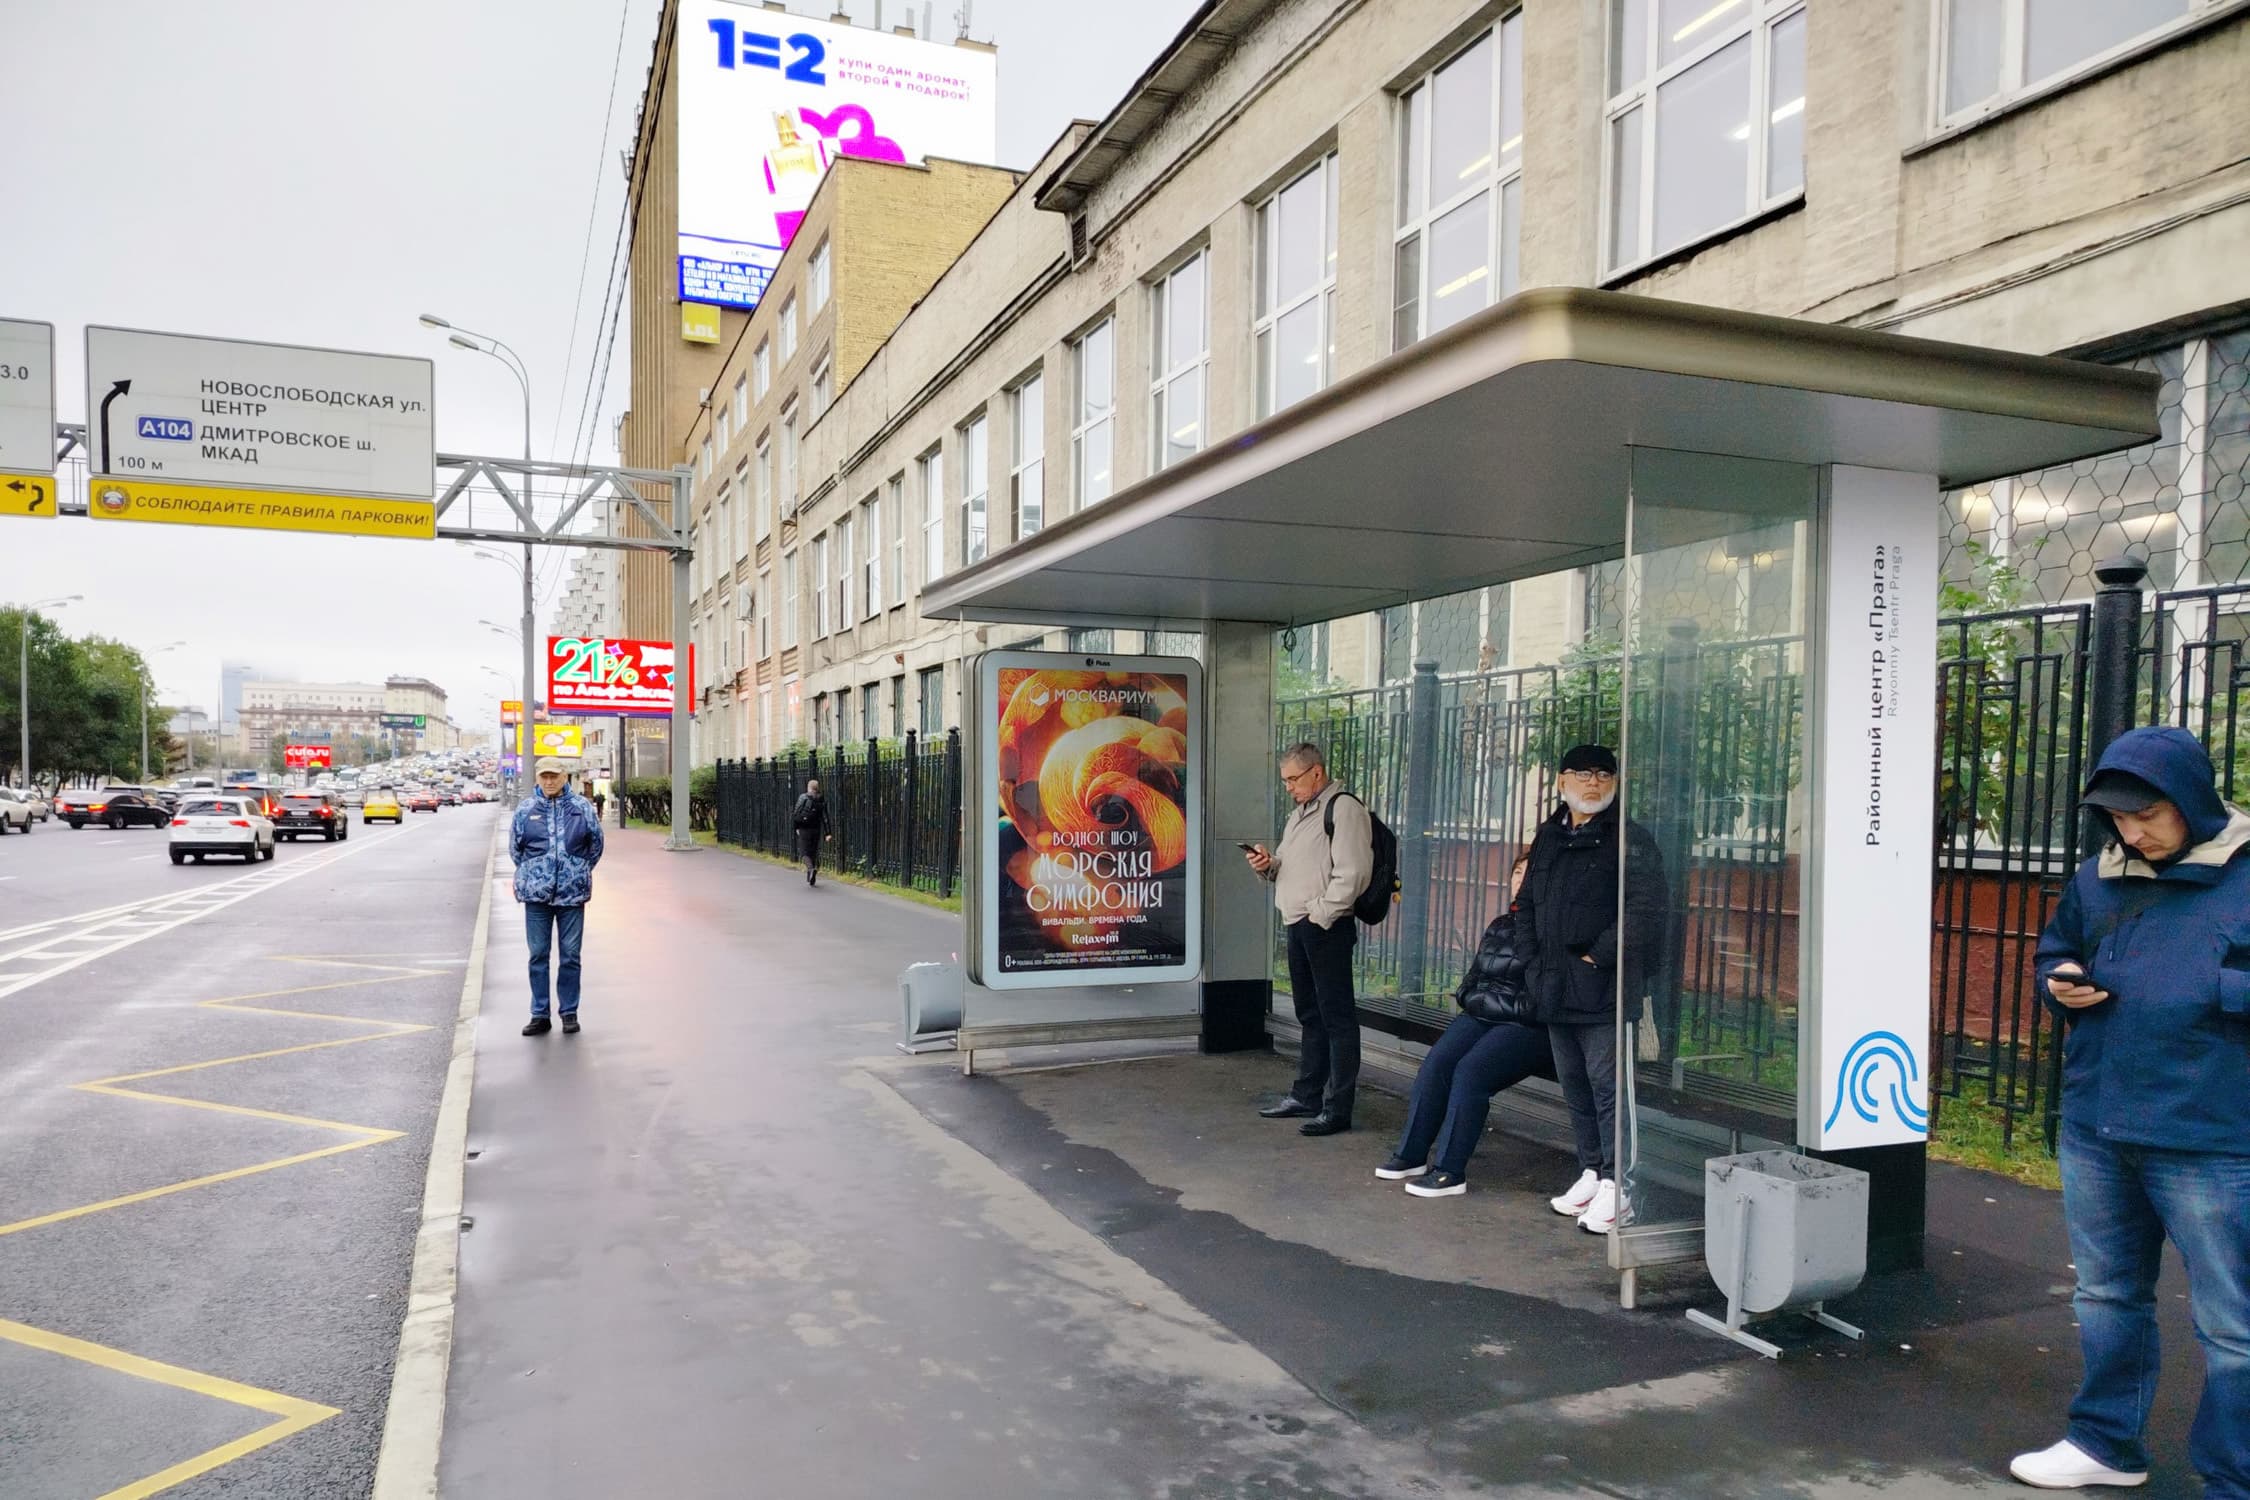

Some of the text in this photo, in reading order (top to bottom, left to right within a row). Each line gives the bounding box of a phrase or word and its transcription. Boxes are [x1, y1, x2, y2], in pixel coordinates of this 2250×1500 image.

[838, 56, 970, 90] купи один аромат,
[838, 69, 889, 86] второй
[906, 82, 970, 102] подарок!
[200, 378, 427, 414] НОВОСЛОБОДСКАЯ ул.
[200, 399, 268, 417] ЦЕНТР
[199, 424, 377, 452] ДМИТРОВСКОЕ ш.
[118, 455, 164, 471] 100 м
[200, 445, 259, 465] МКАД
[135, 495, 256, 516] СОБЛЮДАЙТЕ
[259, 502, 336, 520] ПРАВИЛА
[340, 509, 430, 526] ПАРКОВКИ!
[1889, 545, 1903, 590] Praga
[1888, 594, 1900, 641] Tsentr
[552, 637, 640, 685] 21%
[552, 684, 574, 696] по
[1054, 687, 1158, 704] МОСКВАРИУМ
[1866, 544, 1888, 846] Районный центр «Прага»
[1052, 829, 1139, 849] ВОДНОЕ ШОУ
[1037, 850, 1153, 880] МОРСКАЯ
[1025, 880, 1164, 912] СИМФОНИЯ
[1088, 915, 1125, 925] ВРЕМЕНА
[1126, 914, 1148, 924] ГОДА
[1071, 933, 1101, 946] Relax
[1004, 953, 1017, 969] 0+
